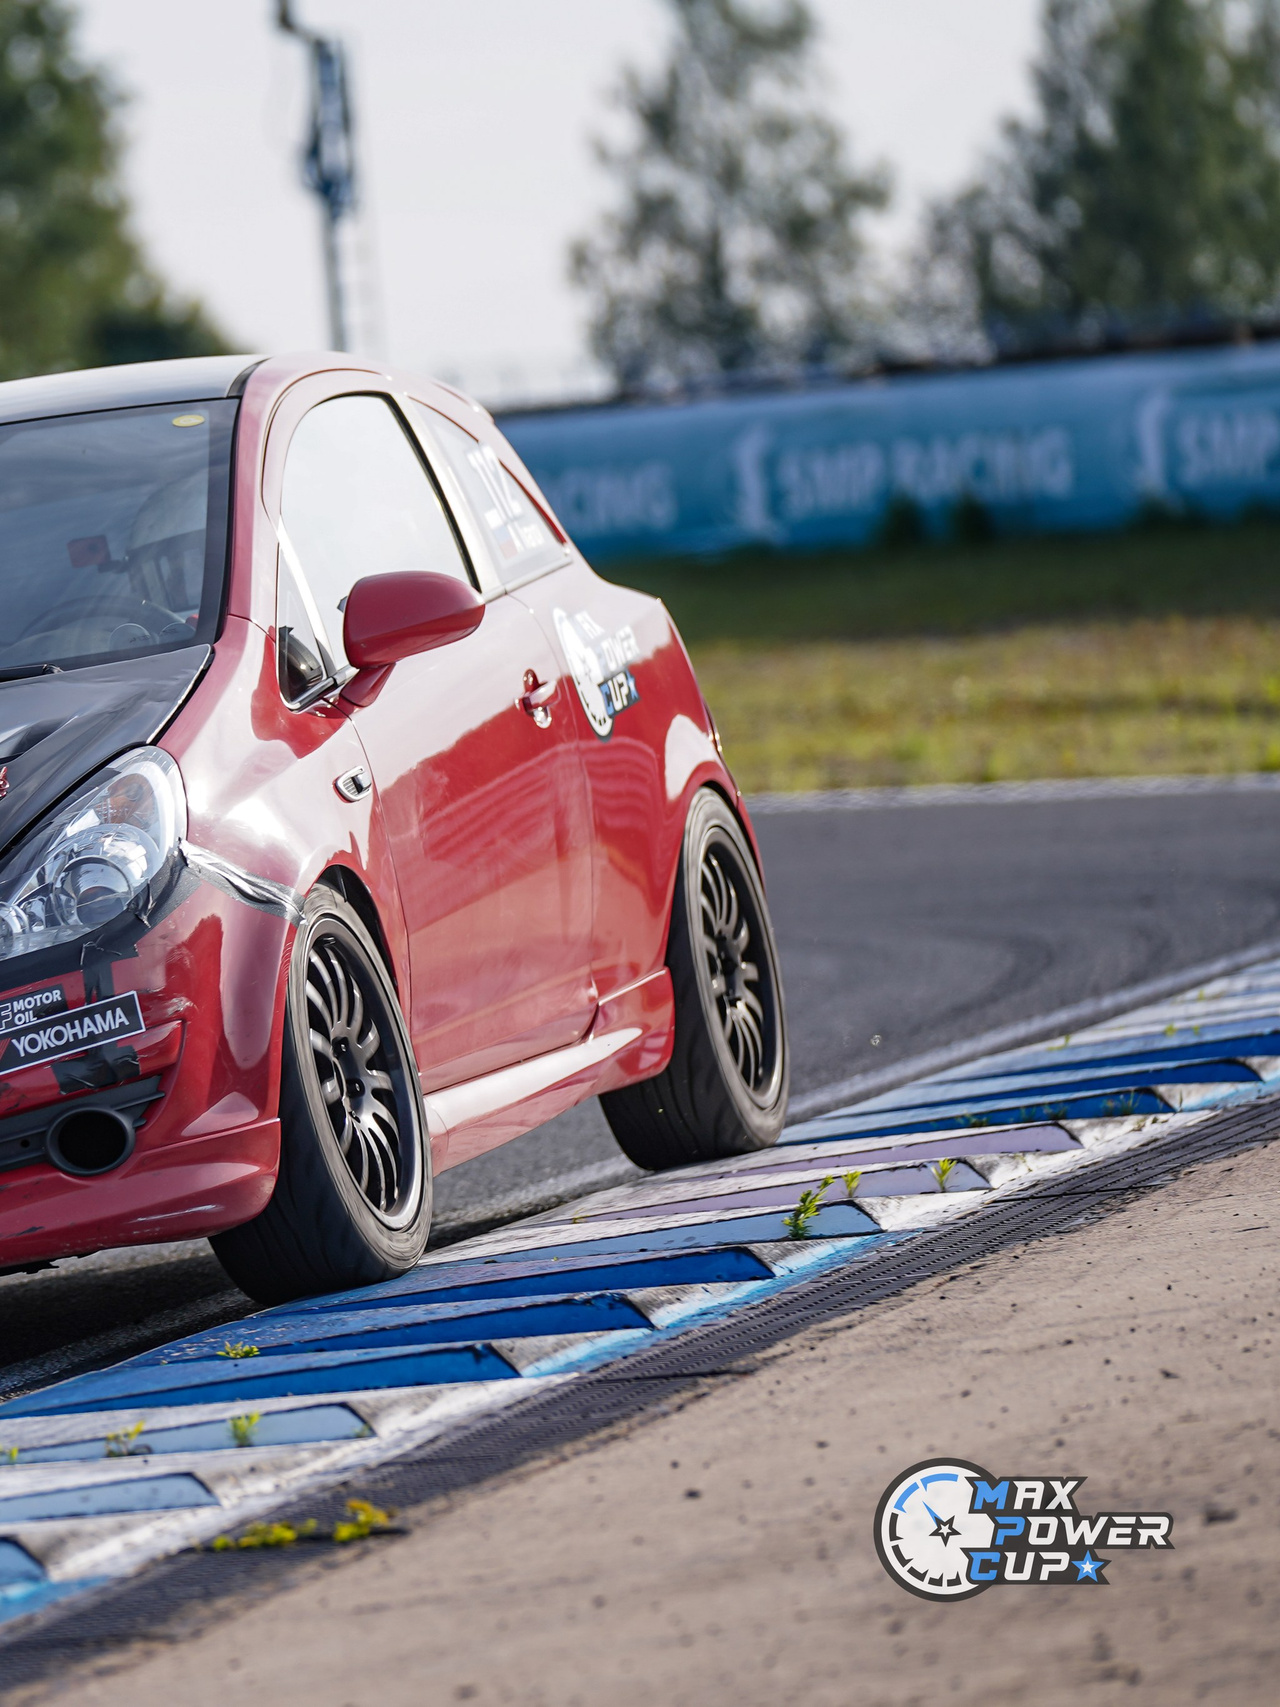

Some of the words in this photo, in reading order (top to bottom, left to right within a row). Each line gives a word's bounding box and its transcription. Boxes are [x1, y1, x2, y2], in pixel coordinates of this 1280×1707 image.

[890, 428, 1072, 508] RACING
[599, 671, 630, 716] CUP
[13, 989, 62, 1014] MOTOR
[13, 1009, 38, 1026] OIL
[11, 1007, 130, 1058] YOKOHAMA
